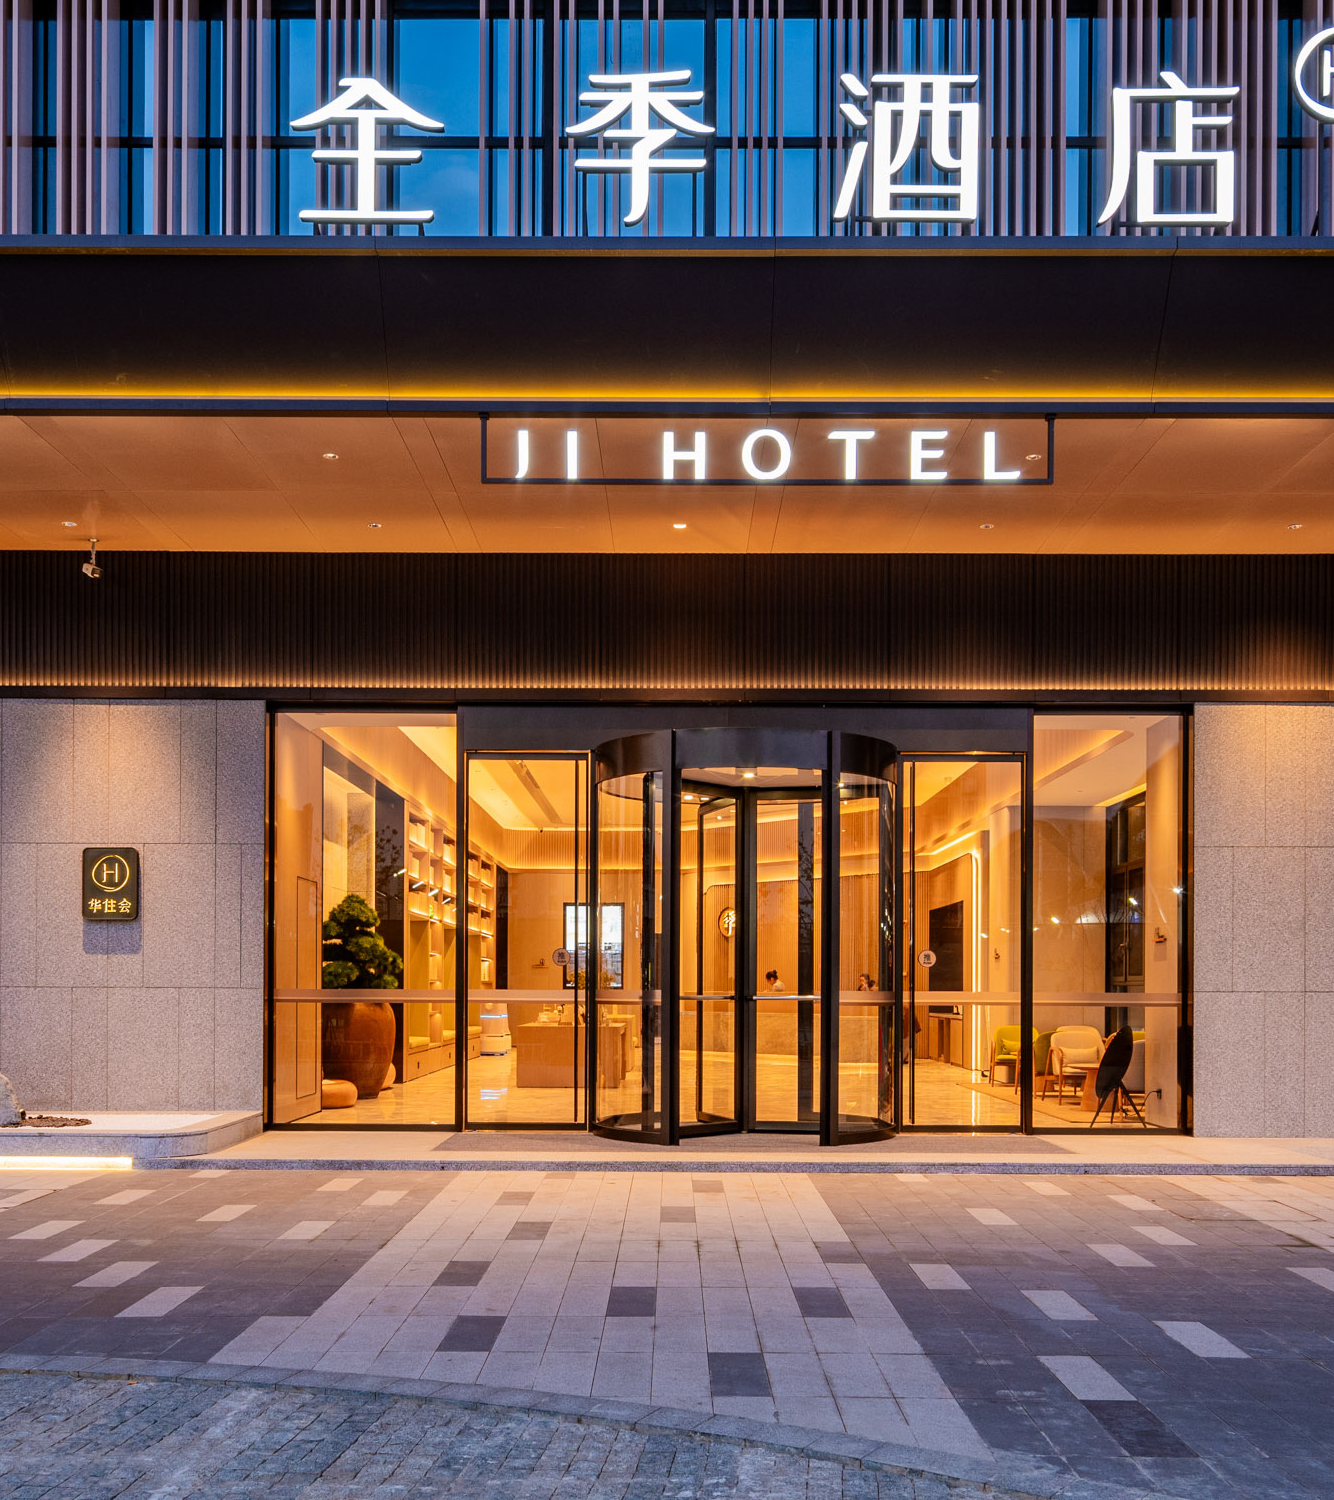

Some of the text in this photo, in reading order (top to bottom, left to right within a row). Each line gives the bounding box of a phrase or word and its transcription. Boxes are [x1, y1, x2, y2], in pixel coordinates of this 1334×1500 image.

[288, 69, 1241, 226] 全季酒店
[515, 429, 1021, 481] JI HOTEL
[88, 897, 132, 913] 华住会
